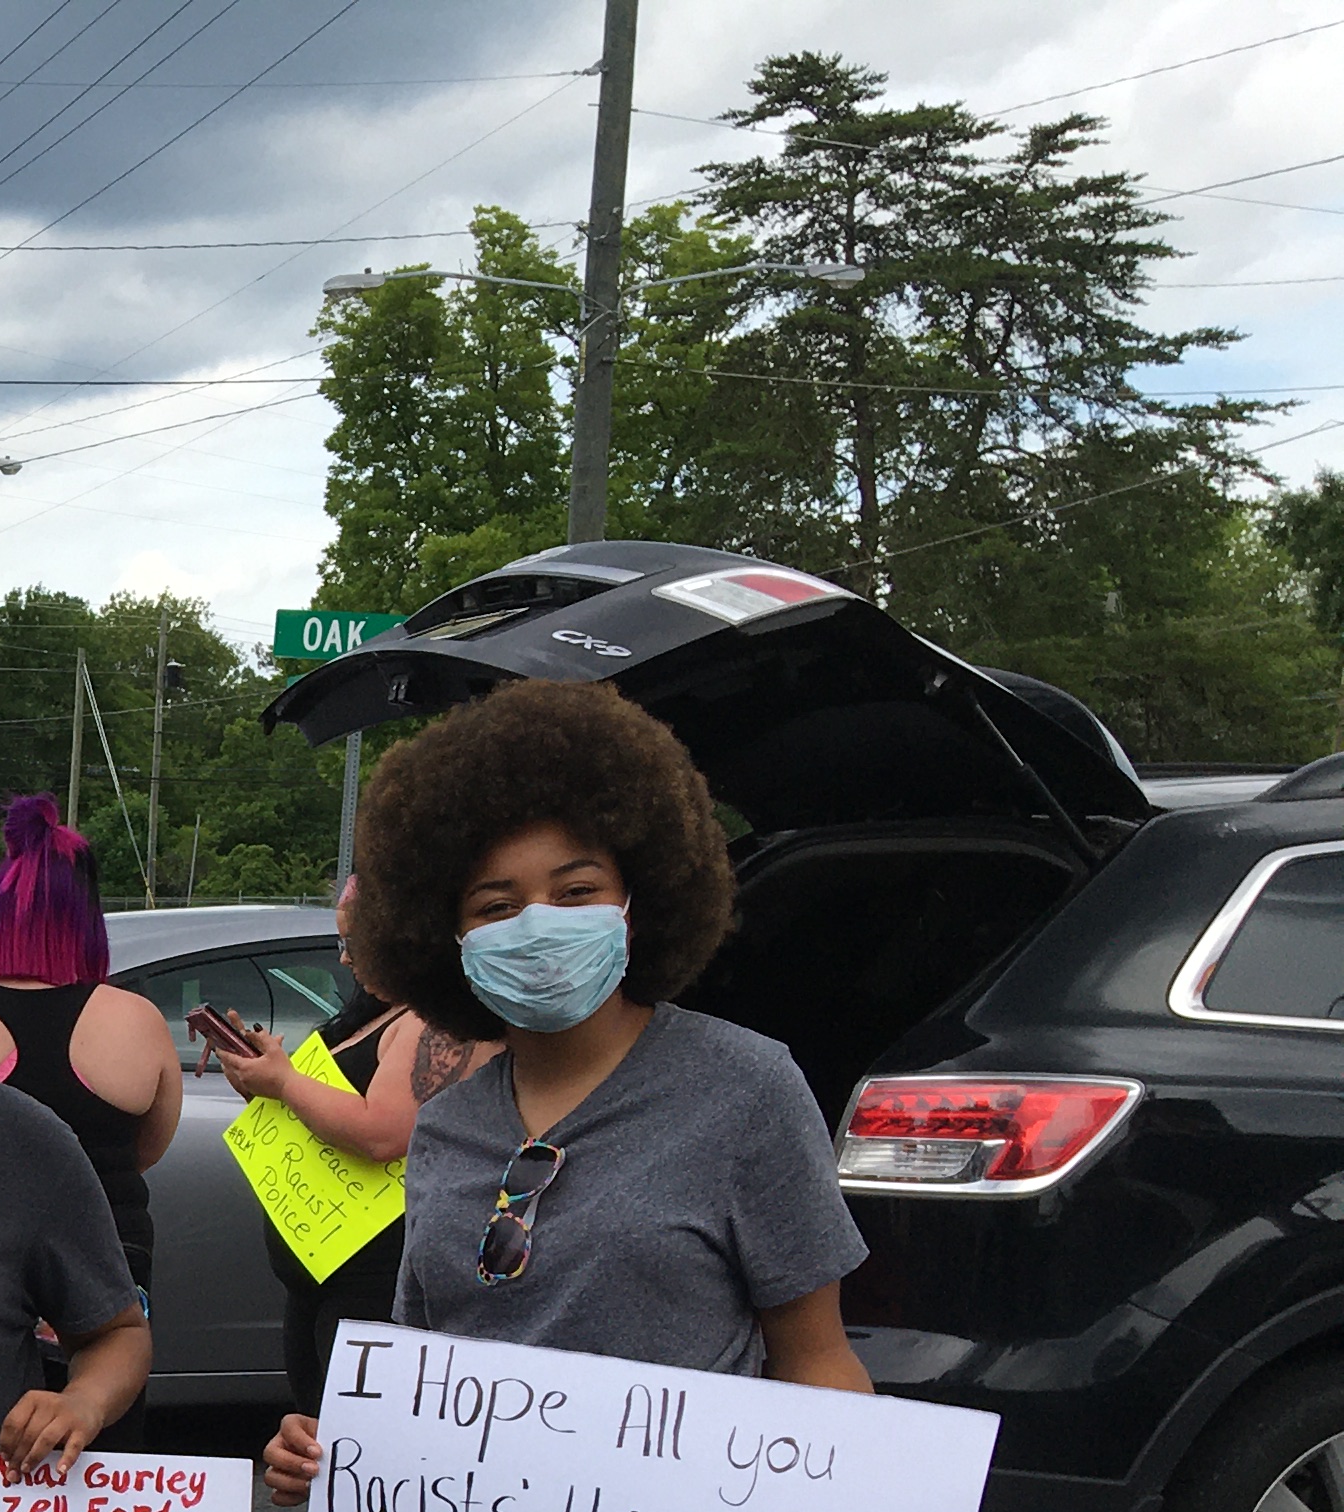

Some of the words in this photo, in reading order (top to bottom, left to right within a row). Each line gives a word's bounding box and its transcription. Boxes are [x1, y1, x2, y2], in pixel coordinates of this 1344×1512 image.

[303, 617, 365, 652] OAK
[552, 629, 632, 658] CX-9
[337, 1340, 393, 1399] I
[412, 1344, 577, 1462] Hope
[616, 1383, 687, 1461] All
[718, 1423, 836, 1506] you
[84, 1462, 206, 1509] Gurley
